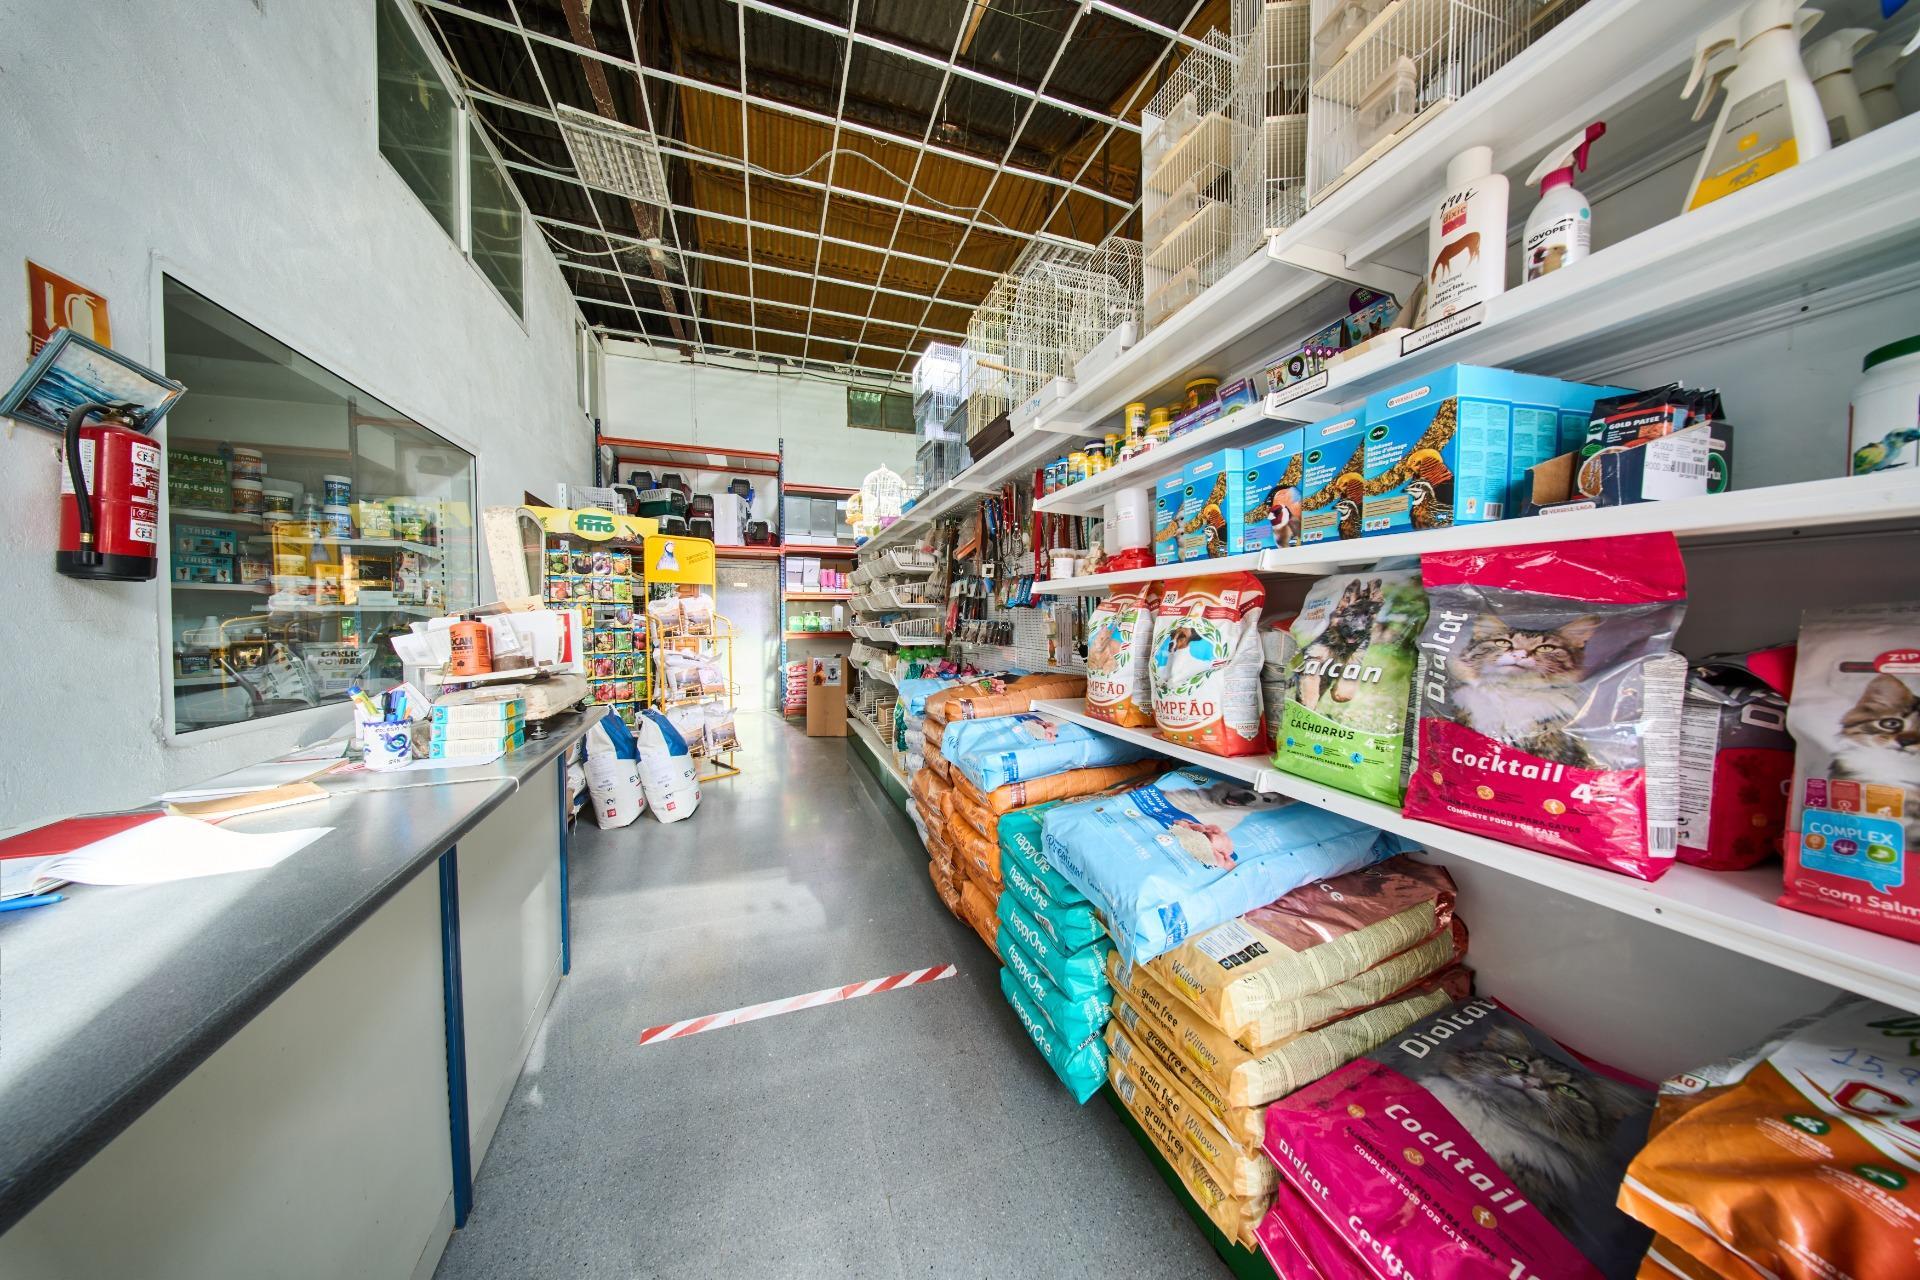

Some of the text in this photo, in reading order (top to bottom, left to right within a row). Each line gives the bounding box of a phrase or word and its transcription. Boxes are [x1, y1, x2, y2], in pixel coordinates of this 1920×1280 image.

[1443, 205, 1467, 222] dixie
[1528, 223, 1573, 244] NOVOPET
[1436, 282, 1465, 299] insectos
[1457, 284, 1477, 296] ponys
[1609, 415, 1661, 430] GOLD PATEE
[316, 657, 363, 666] POWDER
[319, 649, 360, 658] GARLIC
[1425, 610, 1470, 704] Dialcat
[1887, 654, 1918, 665] ZIP
[1451, 747, 1564, 782] Cocktail
[1569, 782, 1596, 804] 4
[1446, 804, 1561, 841] COMPLETE FOOD FOR CATS
[1809, 825, 1893, 857] COMPLEX
[1009, 865, 1049, 911] happyOne
[1818, 887, 1861, 905] com
[1010, 907, 1049, 959] happyOne
[1008, 944, 1048, 1002] happyOne
[1171, 959, 1207, 995] Willowy
[1011, 991, 1053, 1057] happyOne
[1141, 987, 1161, 1011] grain
[1162, 1004, 1179, 1027] free
[1183, 1026, 1220, 1066] Willowy
[1398, 998, 1498, 1060] Dialcat
[1147, 1030, 1188, 1074] grain free
[1139, 1065, 1161, 1092] grain
[1160, 1088, 1180, 1113] free
[1191, 1076, 1228, 1113] Willowy
[1144, 1104, 1168, 1132] grain
[1167, 1126, 1185, 1154] free
[1183, 1114, 1221, 1155] Willowy
[1278, 1138, 1330, 1201] Dialcat
[1384, 1103, 1528, 1215] Cocktail
[1190, 1157, 1227, 1202] Willowy
[1353, 1143, 1470, 1251] COMPLETE FOOD FOR CATS
[1386, 1159, 1432, 1202] COMPLETO
[1461, 1228, 1498, 1261] GATOS
